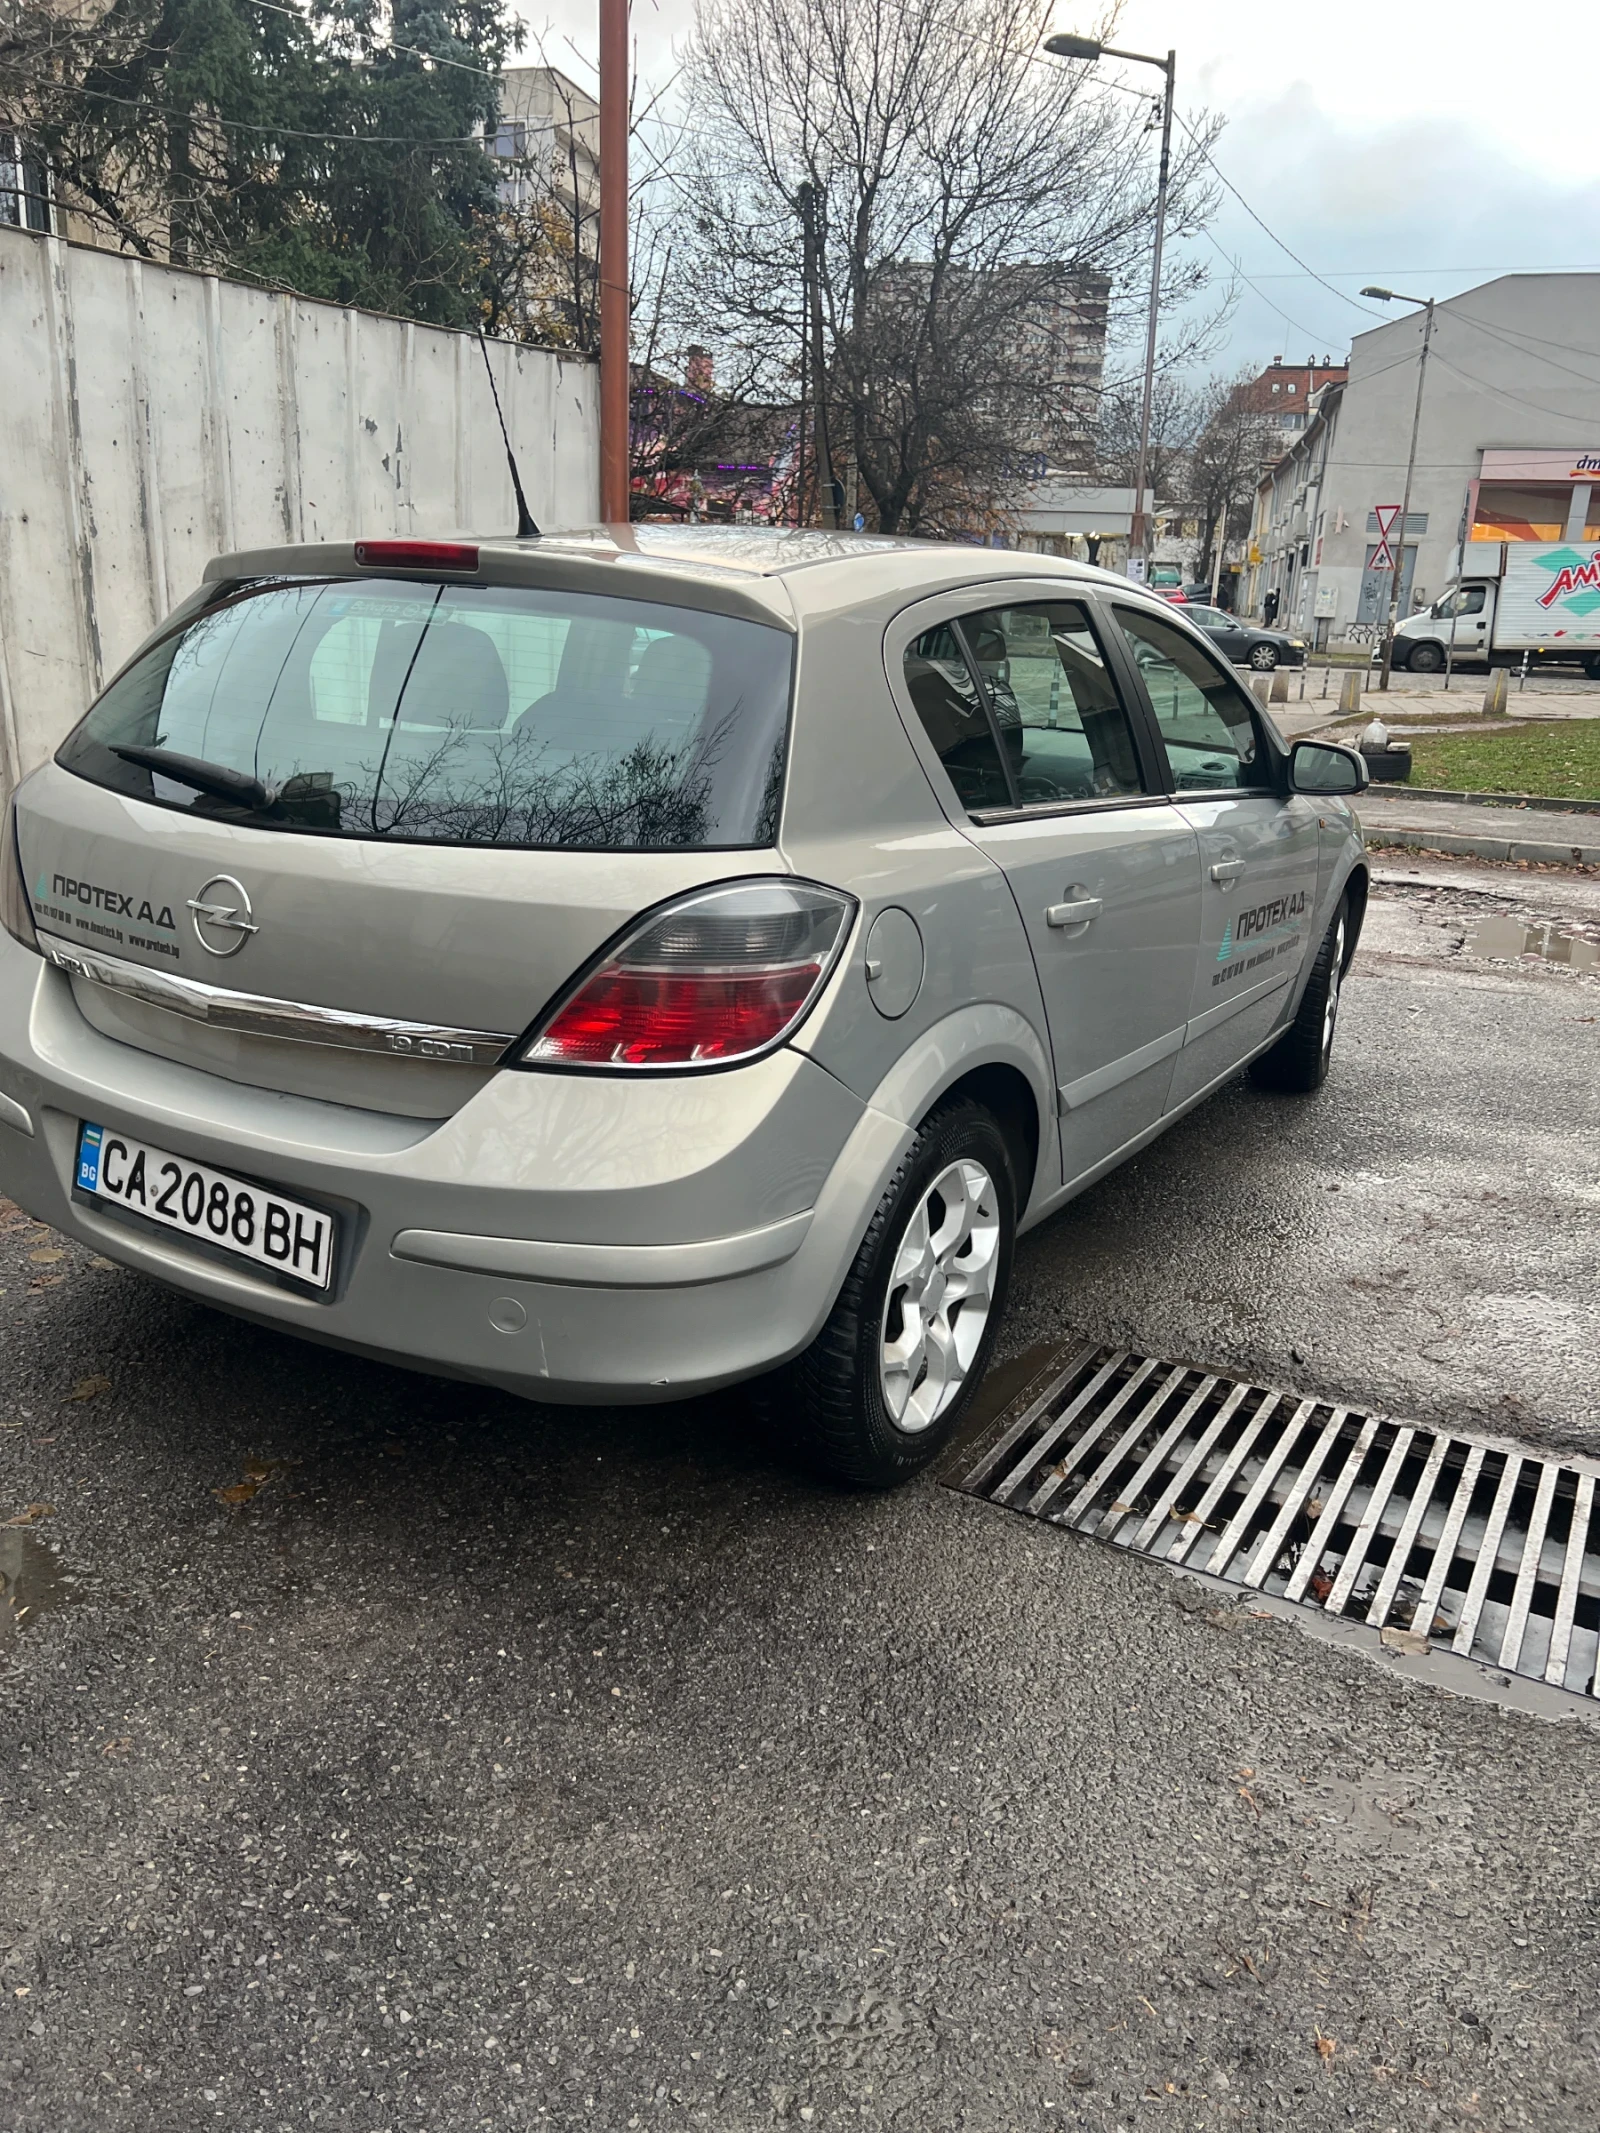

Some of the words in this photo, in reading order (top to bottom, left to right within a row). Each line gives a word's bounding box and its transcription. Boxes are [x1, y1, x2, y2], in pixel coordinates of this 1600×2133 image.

[1537, 550, 1600, 609] AM
[53, 873, 133, 918] ПРОТЕХ
[1236, 896, 1289, 940] ПРОТЕХ
[51, 950, 91, 978] ASTRA
[419, 1039, 473, 1061] CDTI
[81, 1162, 97, 1182] BG
